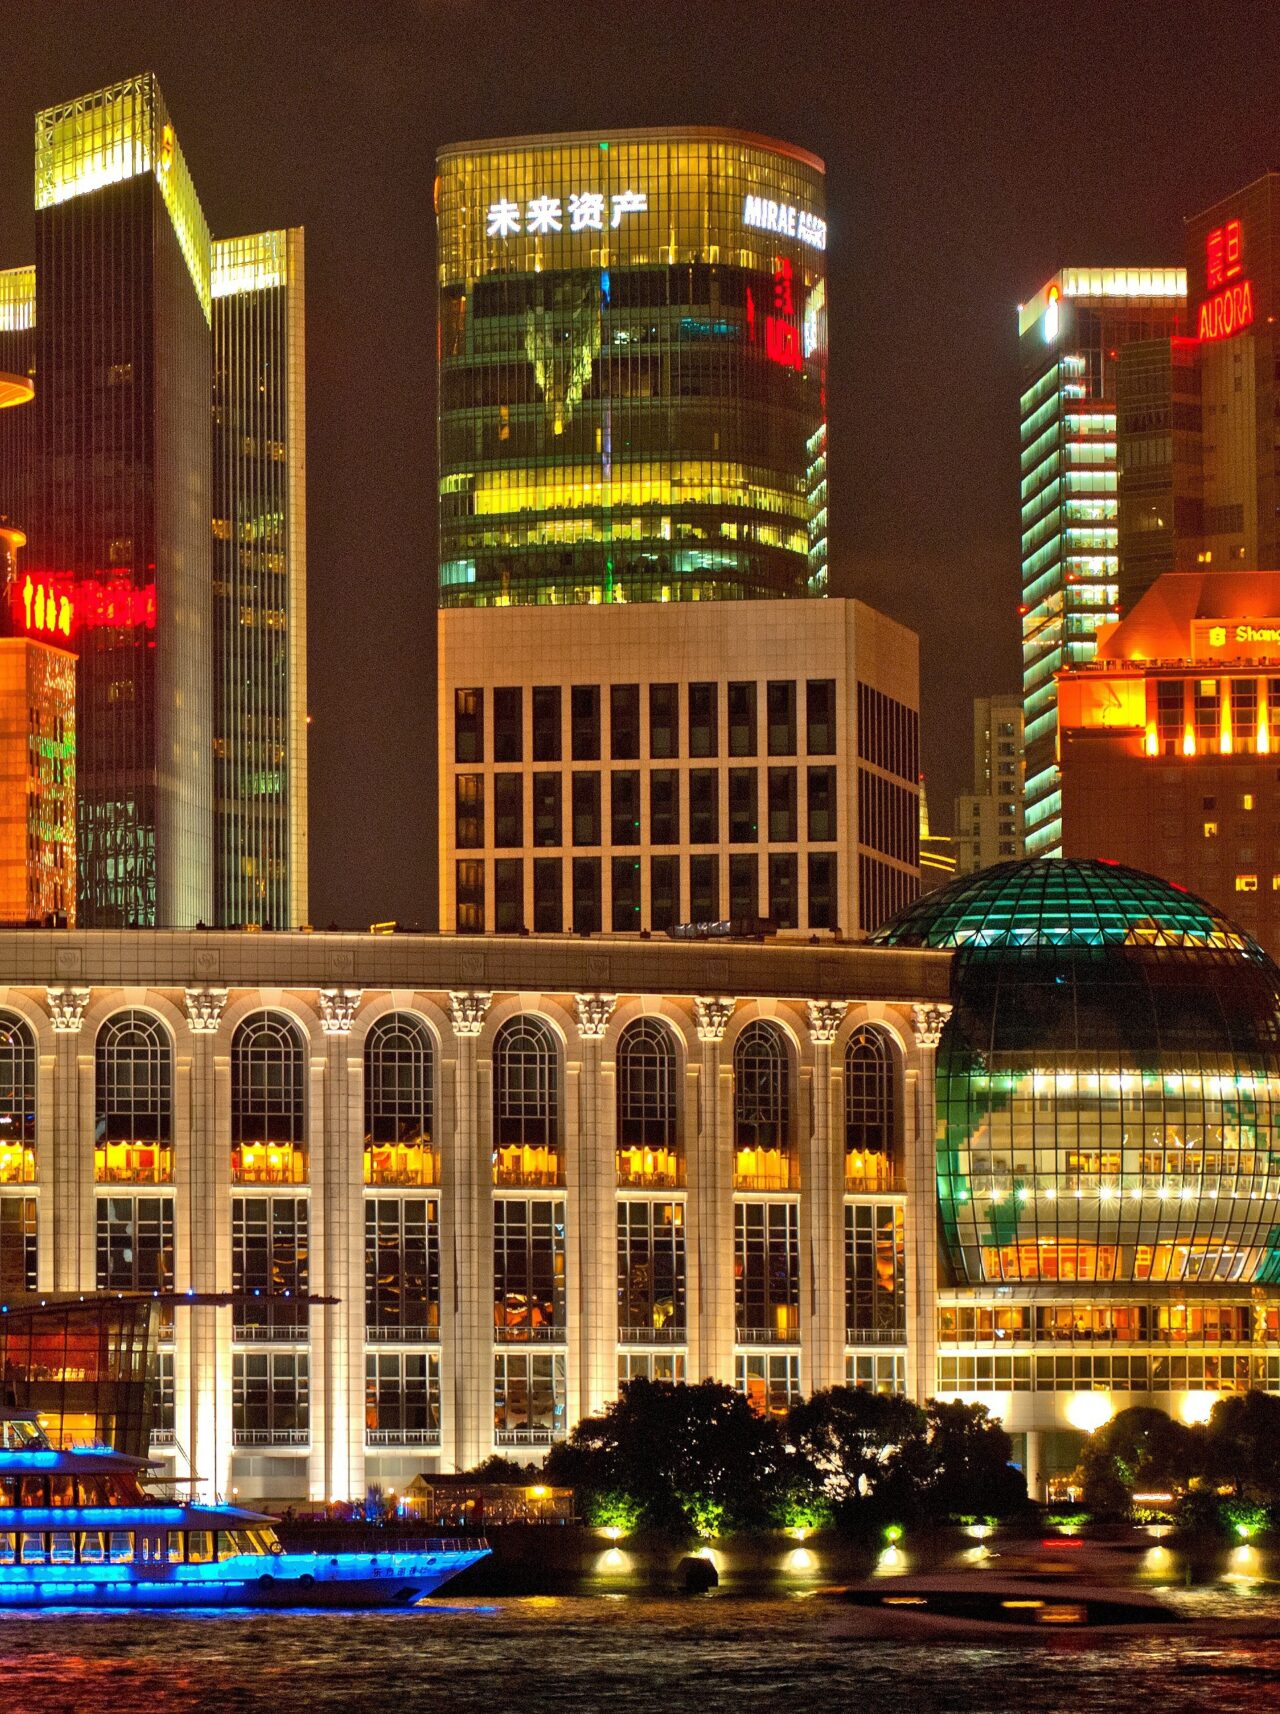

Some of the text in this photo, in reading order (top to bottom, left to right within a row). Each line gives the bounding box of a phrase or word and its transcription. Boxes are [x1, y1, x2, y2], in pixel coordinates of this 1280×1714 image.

[486, 190, 648, 237] 未来资产
[744, 194, 797, 237] MIRAE
[1199, 281, 1253, 339] AURORA
